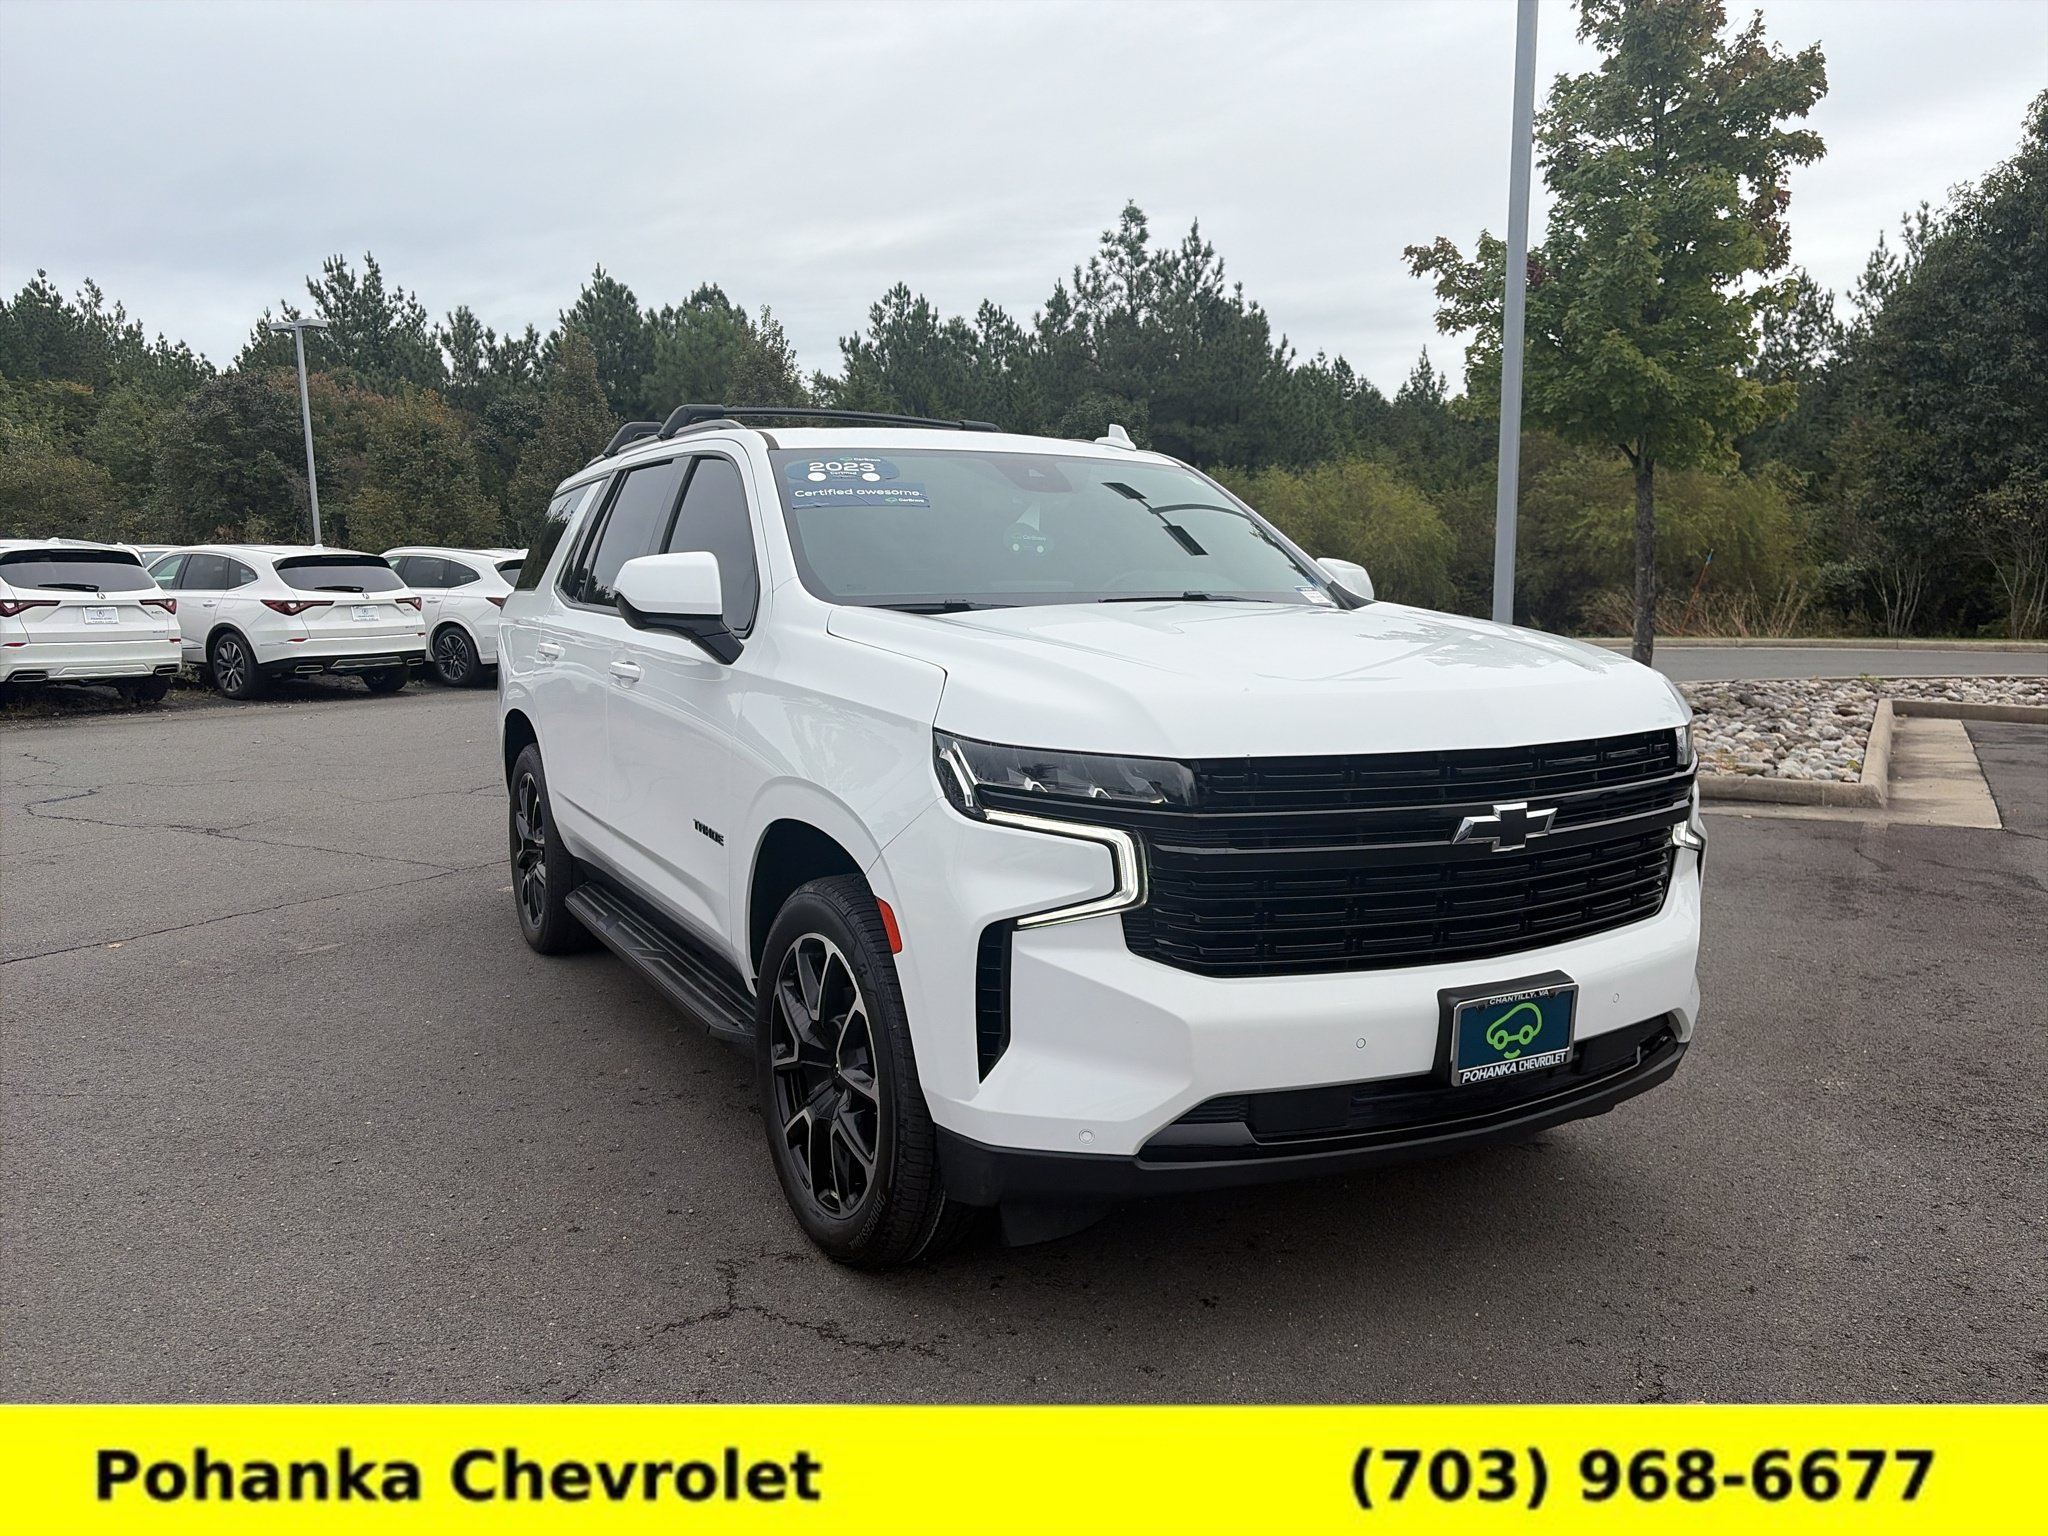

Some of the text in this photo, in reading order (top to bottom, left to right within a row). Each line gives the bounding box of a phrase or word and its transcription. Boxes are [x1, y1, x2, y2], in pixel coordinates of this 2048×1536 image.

[808, 461, 876, 472] 2023
[794, 488, 924, 498] Certified awesome.
[692, 818, 724, 846] TAHOE
[1539, 989, 1549, 997] VA
[1461, 1052, 1567, 1084] POHANKA CHEVROLET
